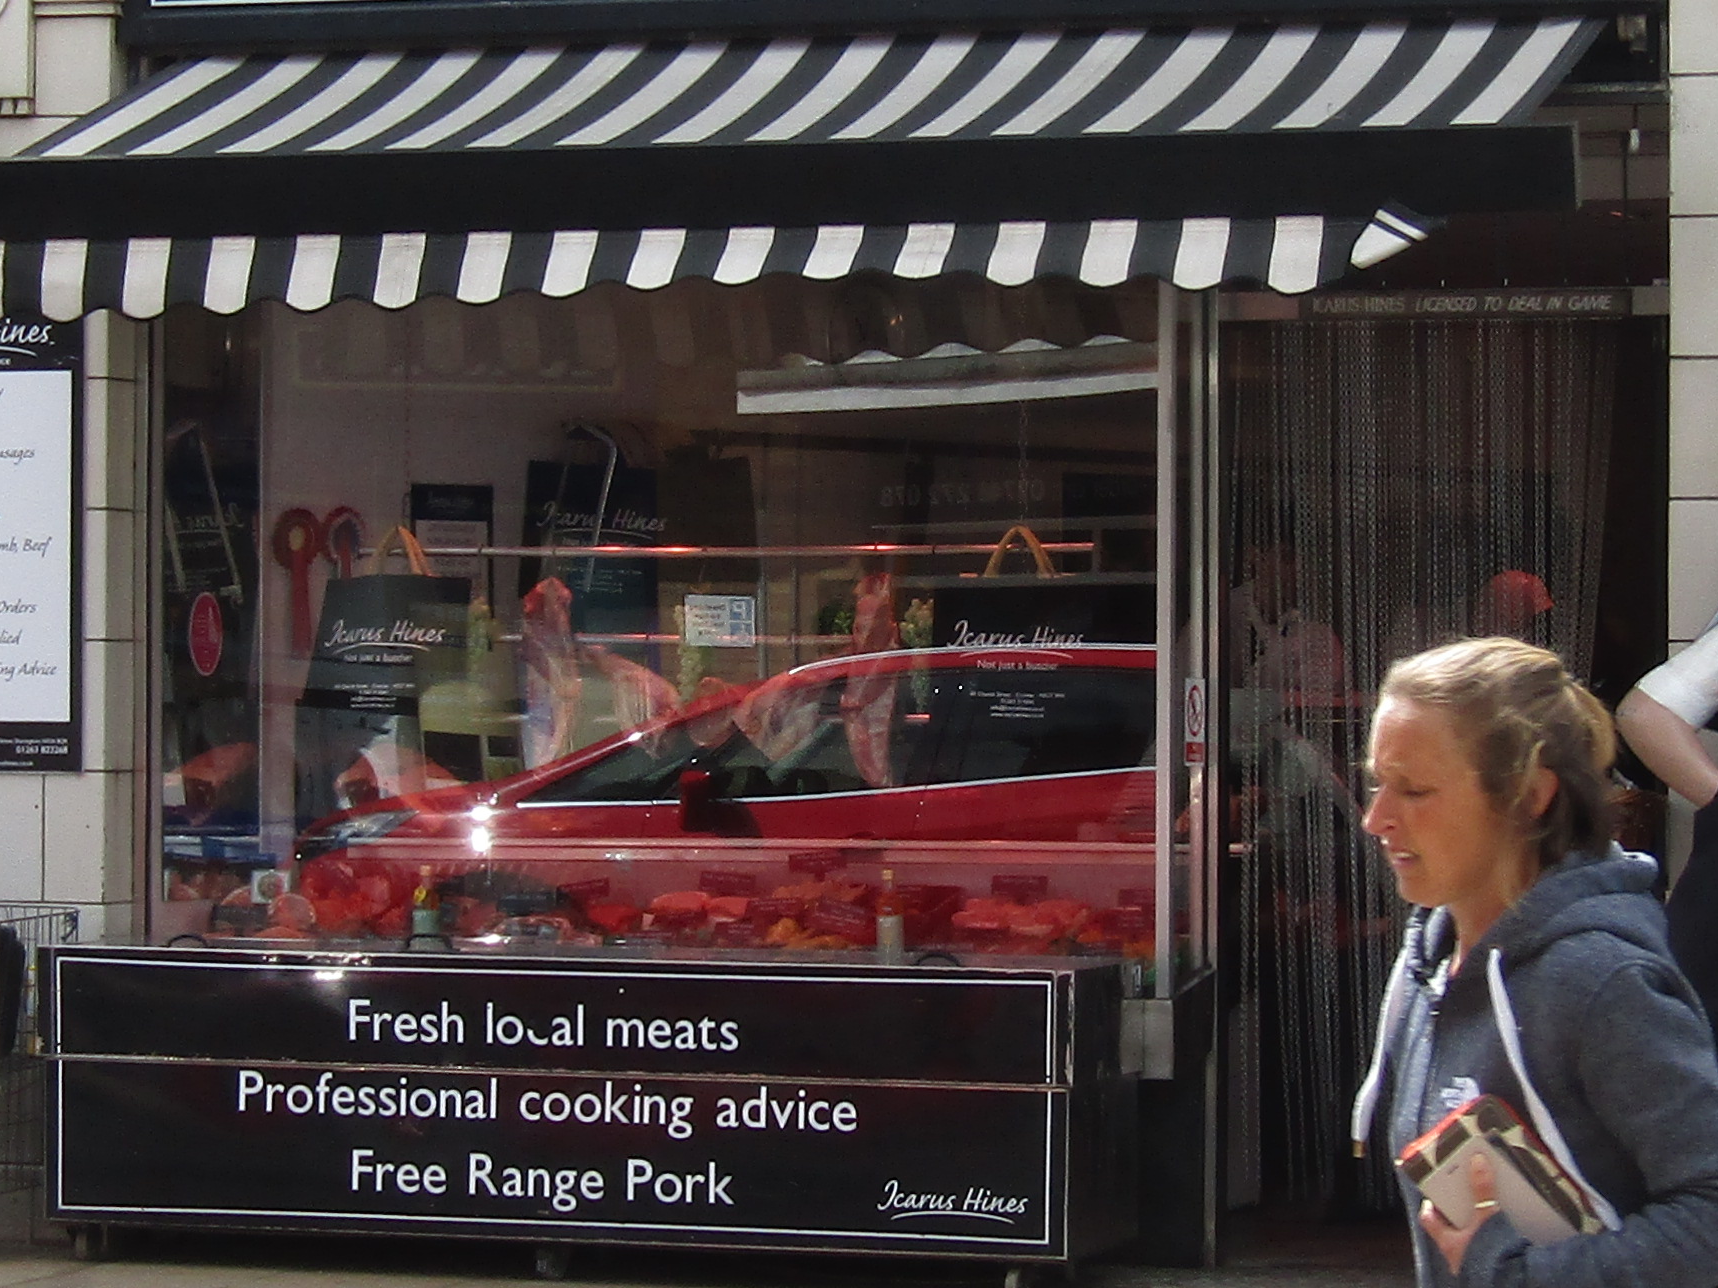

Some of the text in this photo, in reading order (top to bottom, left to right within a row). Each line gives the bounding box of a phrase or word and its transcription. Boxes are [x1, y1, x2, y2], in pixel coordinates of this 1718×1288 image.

[1415, 296, 1476, 311] LICENSED
[1484, 295, 1502, 310] TO
[1508, 295, 1543, 310] DEAL
[1545, 295, 1562, 310] IN
[1568, 294, 1612, 310] GAME
[23, 538, 52, 557] Beef
[389, 619, 447, 643] Hines
[947, 619, 1025, 648] Icarus
[18, 662, 57, 676] Advice
[348, 999, 465, 1045] Fresh
[605, 1010, 739, 1052] meats
[237, 1072, 858, 1139] Professional cooking advice
[351, 1151, 734, 1211] Free Range Pork
[877, 1178, 1028, 1215] Icarus Hines
